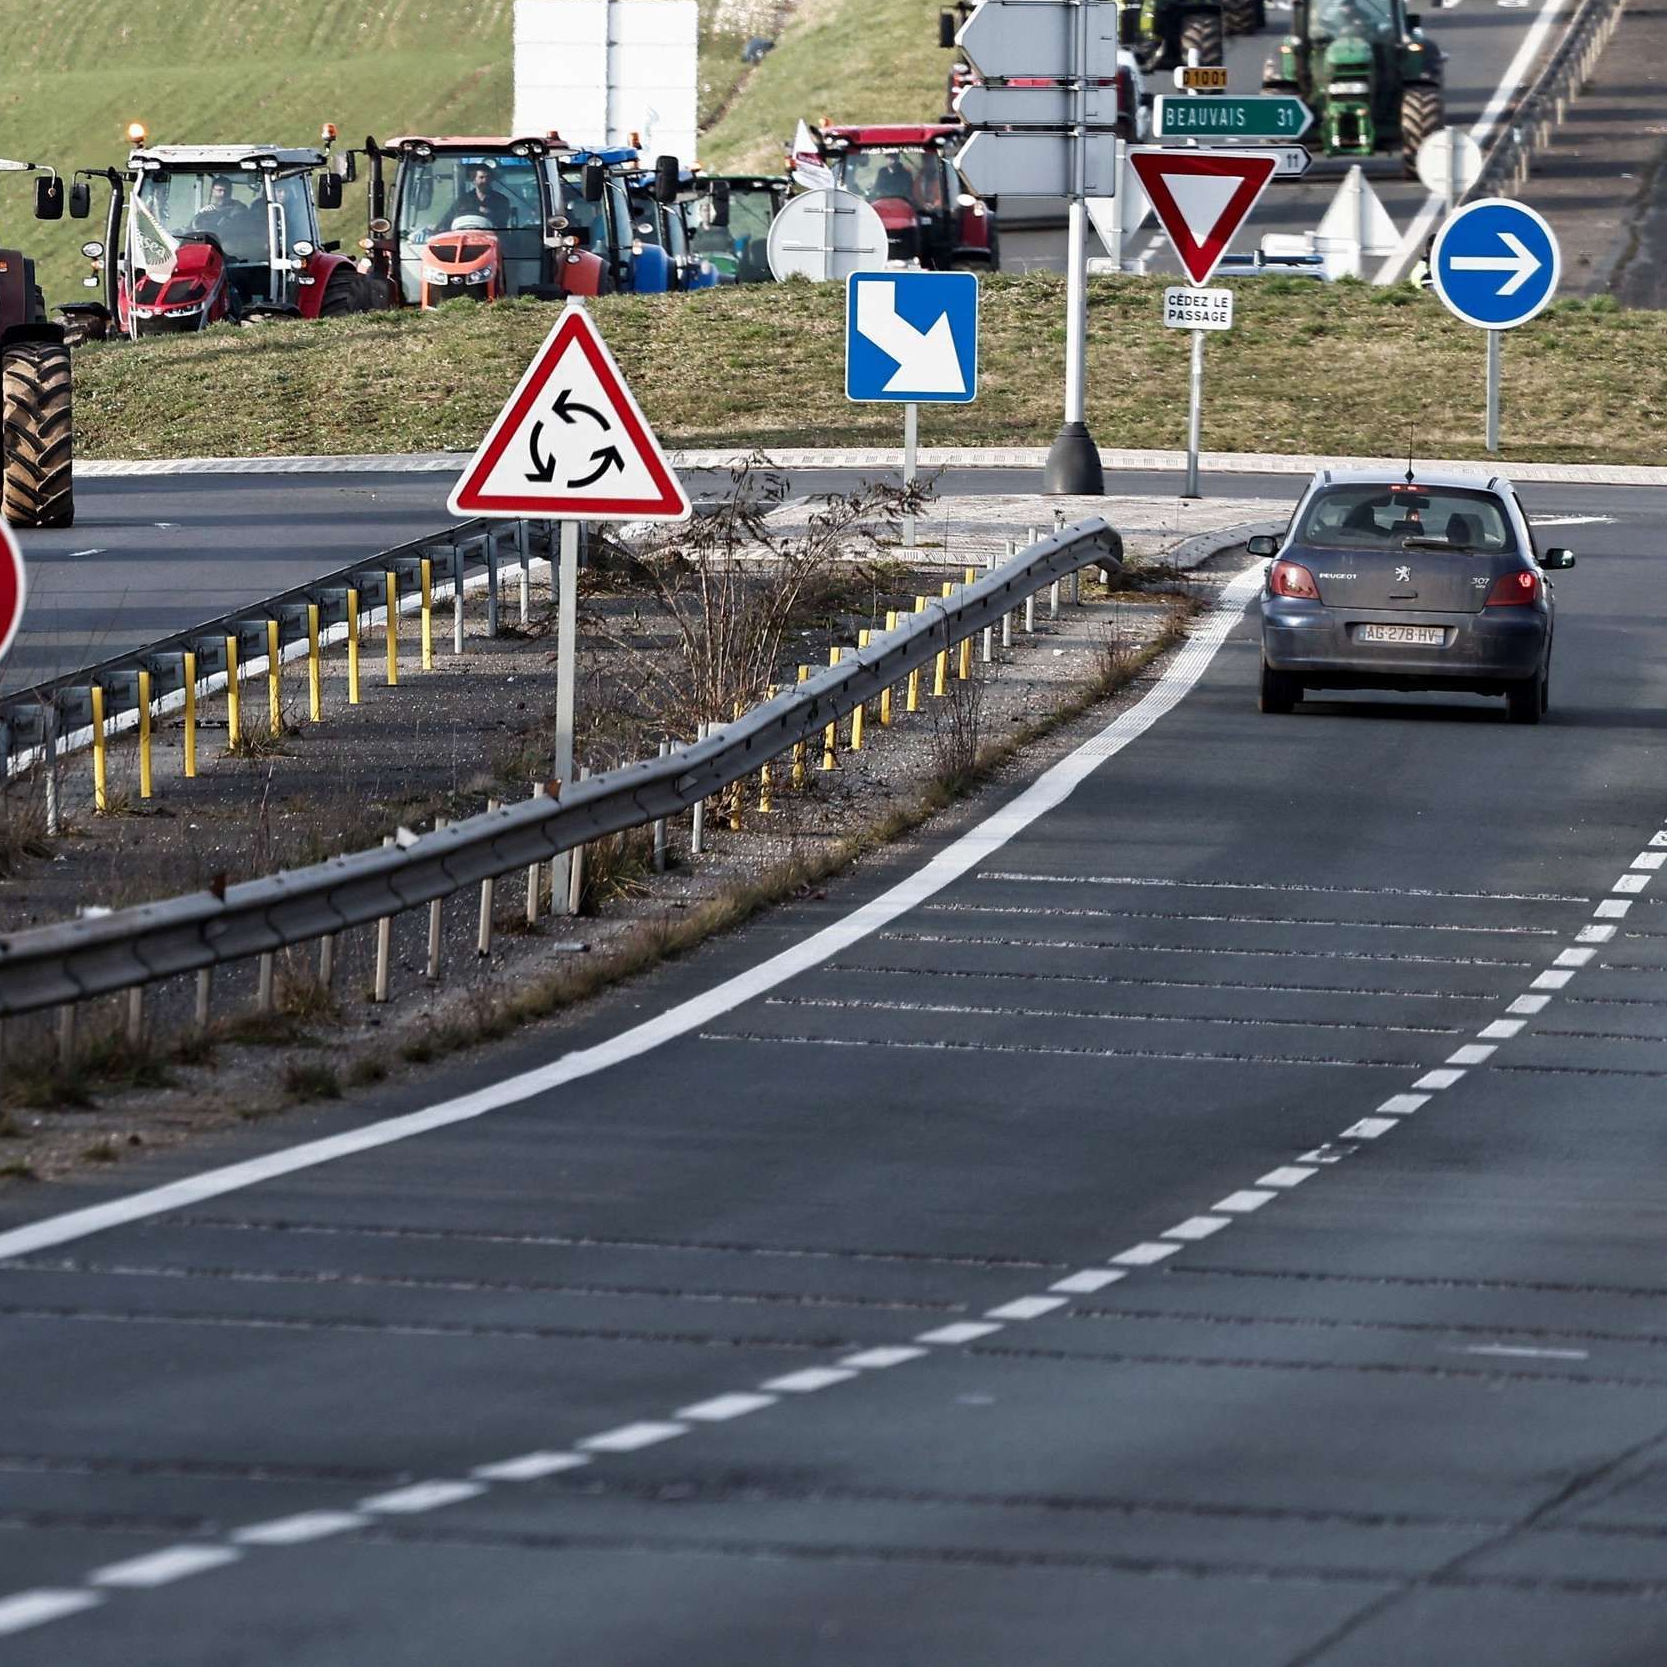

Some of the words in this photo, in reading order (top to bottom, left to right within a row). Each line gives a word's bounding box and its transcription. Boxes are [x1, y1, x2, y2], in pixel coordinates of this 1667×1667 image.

[1166, 108, 1246, 127] BEAUVAIS
[1276, 108, 1295, 127] 31
[1286, 153, 1299, 168] 11
[1168, 293, 1209, 307] CÉDEZ
[1213, 297, 1229, 308] LE
[1168, 310, 1228, 322] PASSAGE
[1319, 572, 1357, 580] PEUGEOT
[1470, 577, 1491, 585] 307
[1366, 625, 1437, 642] AG-278-HV
